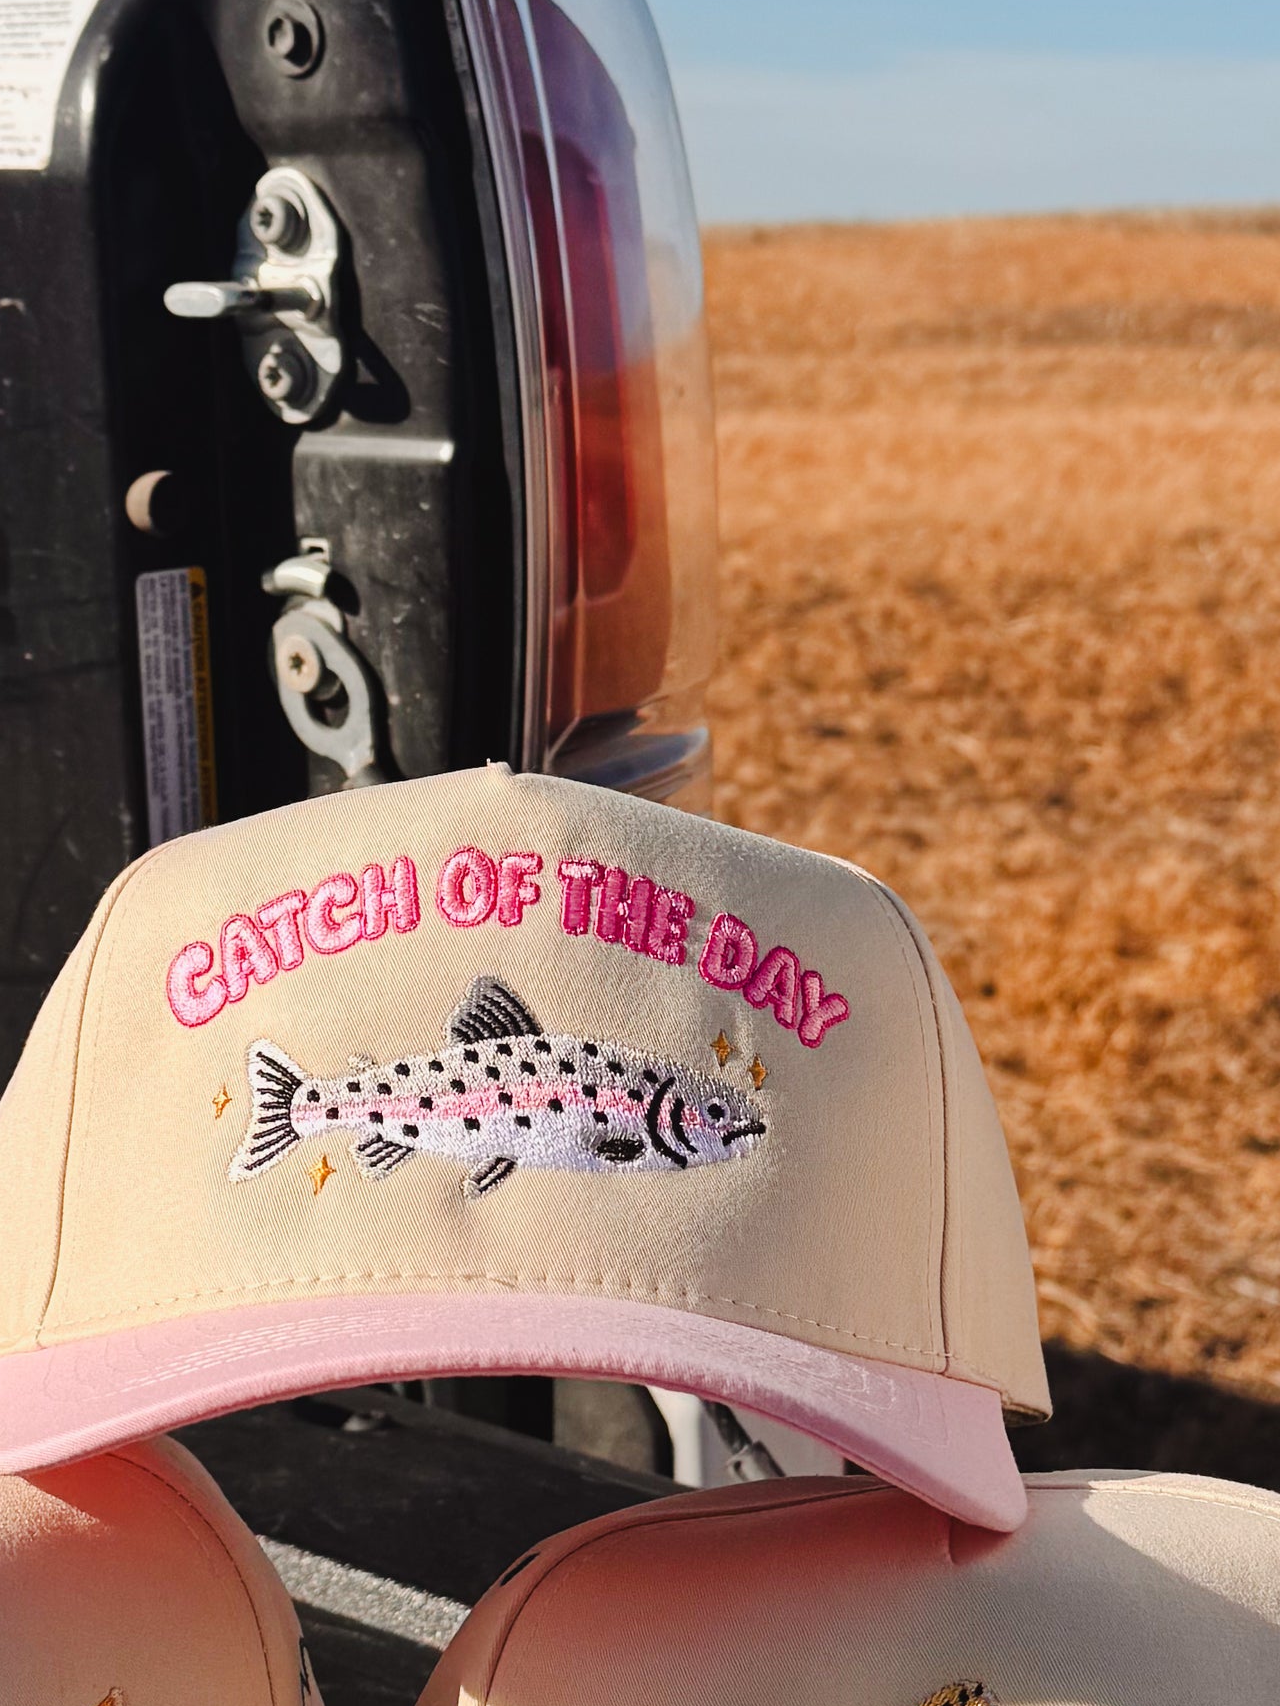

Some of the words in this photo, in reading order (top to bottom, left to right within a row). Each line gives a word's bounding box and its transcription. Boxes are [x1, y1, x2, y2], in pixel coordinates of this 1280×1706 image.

[166, 855, 420, 1028] CATCH
[437, 845, 543, 928] OF
[558, 857, 696, 966] THE
[698, 911, 850, 1049] DAY
